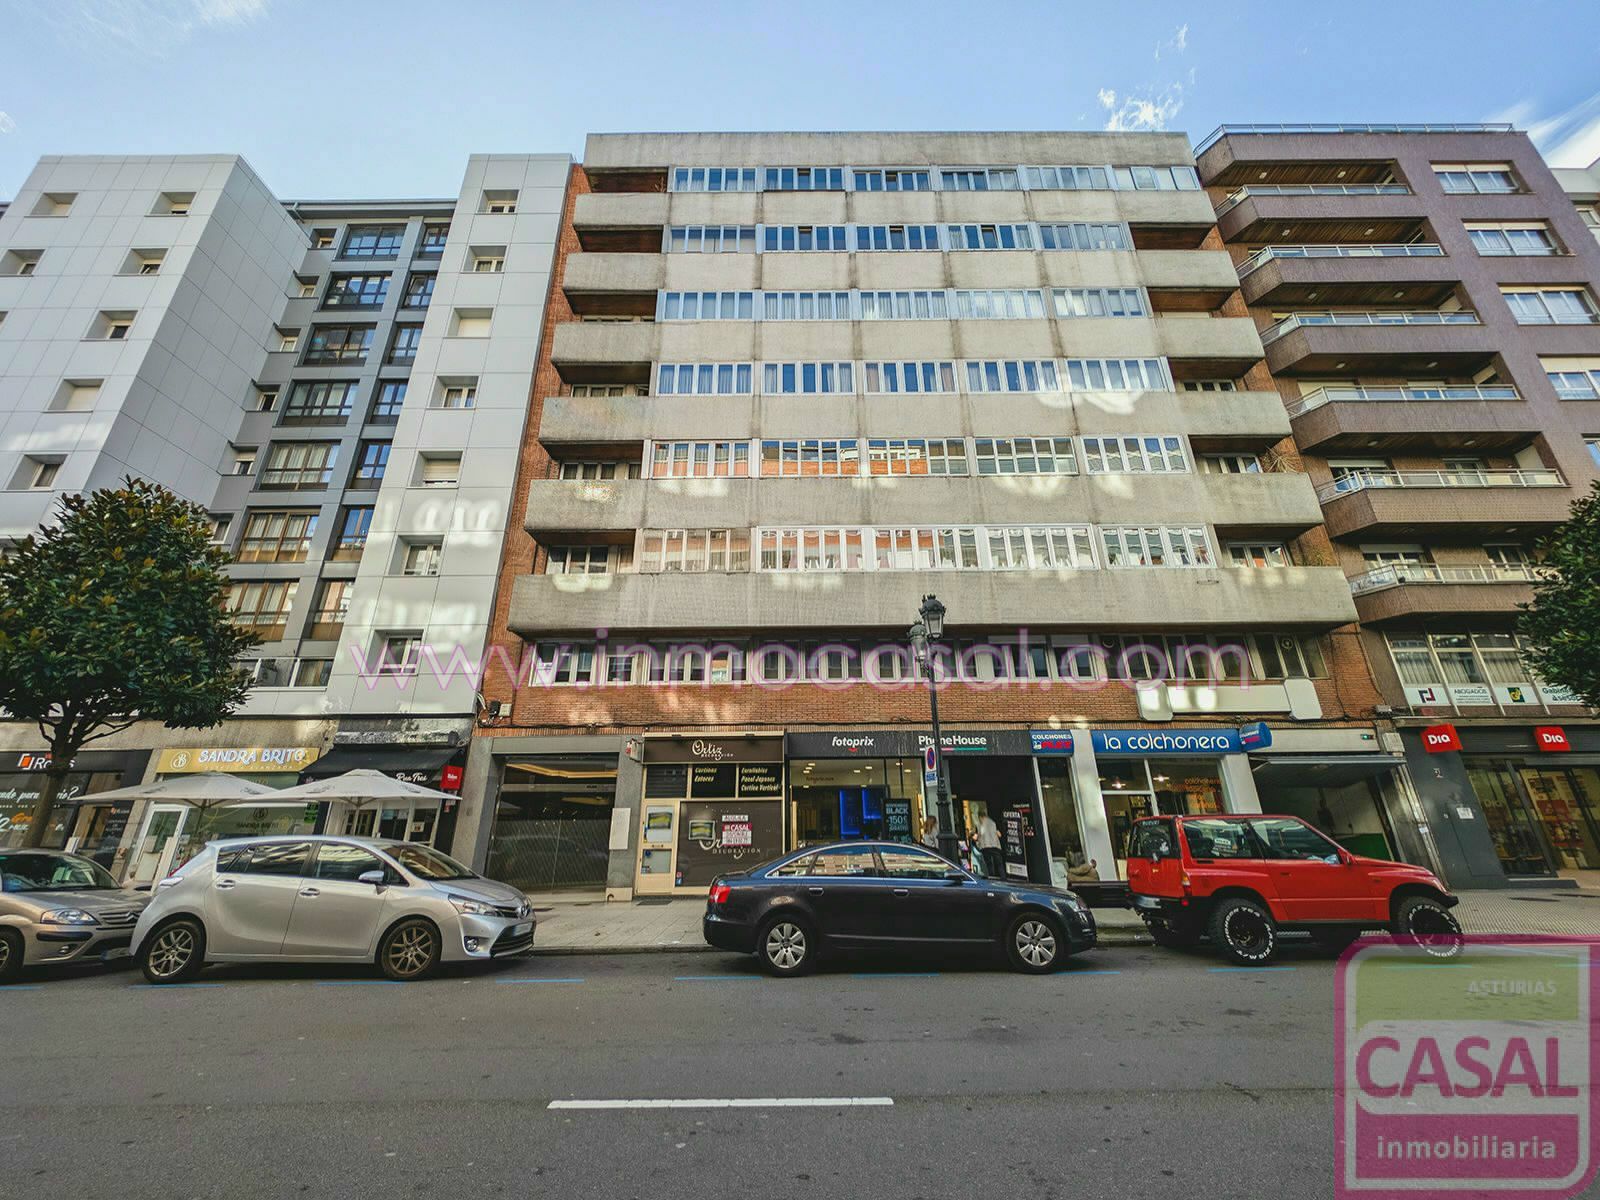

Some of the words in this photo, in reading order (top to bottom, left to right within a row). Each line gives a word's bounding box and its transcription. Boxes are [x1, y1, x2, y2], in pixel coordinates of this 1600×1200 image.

[831, 736, 875, 749] fotoprix
[918, 735, 987, 745] PhneHouse
[1103, 733, 1121, 749] la
[1127, 733, 1230, 749] colchonera
[198, 749, 257, 765] SANDRA
[260, 748, 306, 765] BRITO
[692, 740, 722, 760] Ortiz
[886, 807, 908, 815] BLACK
